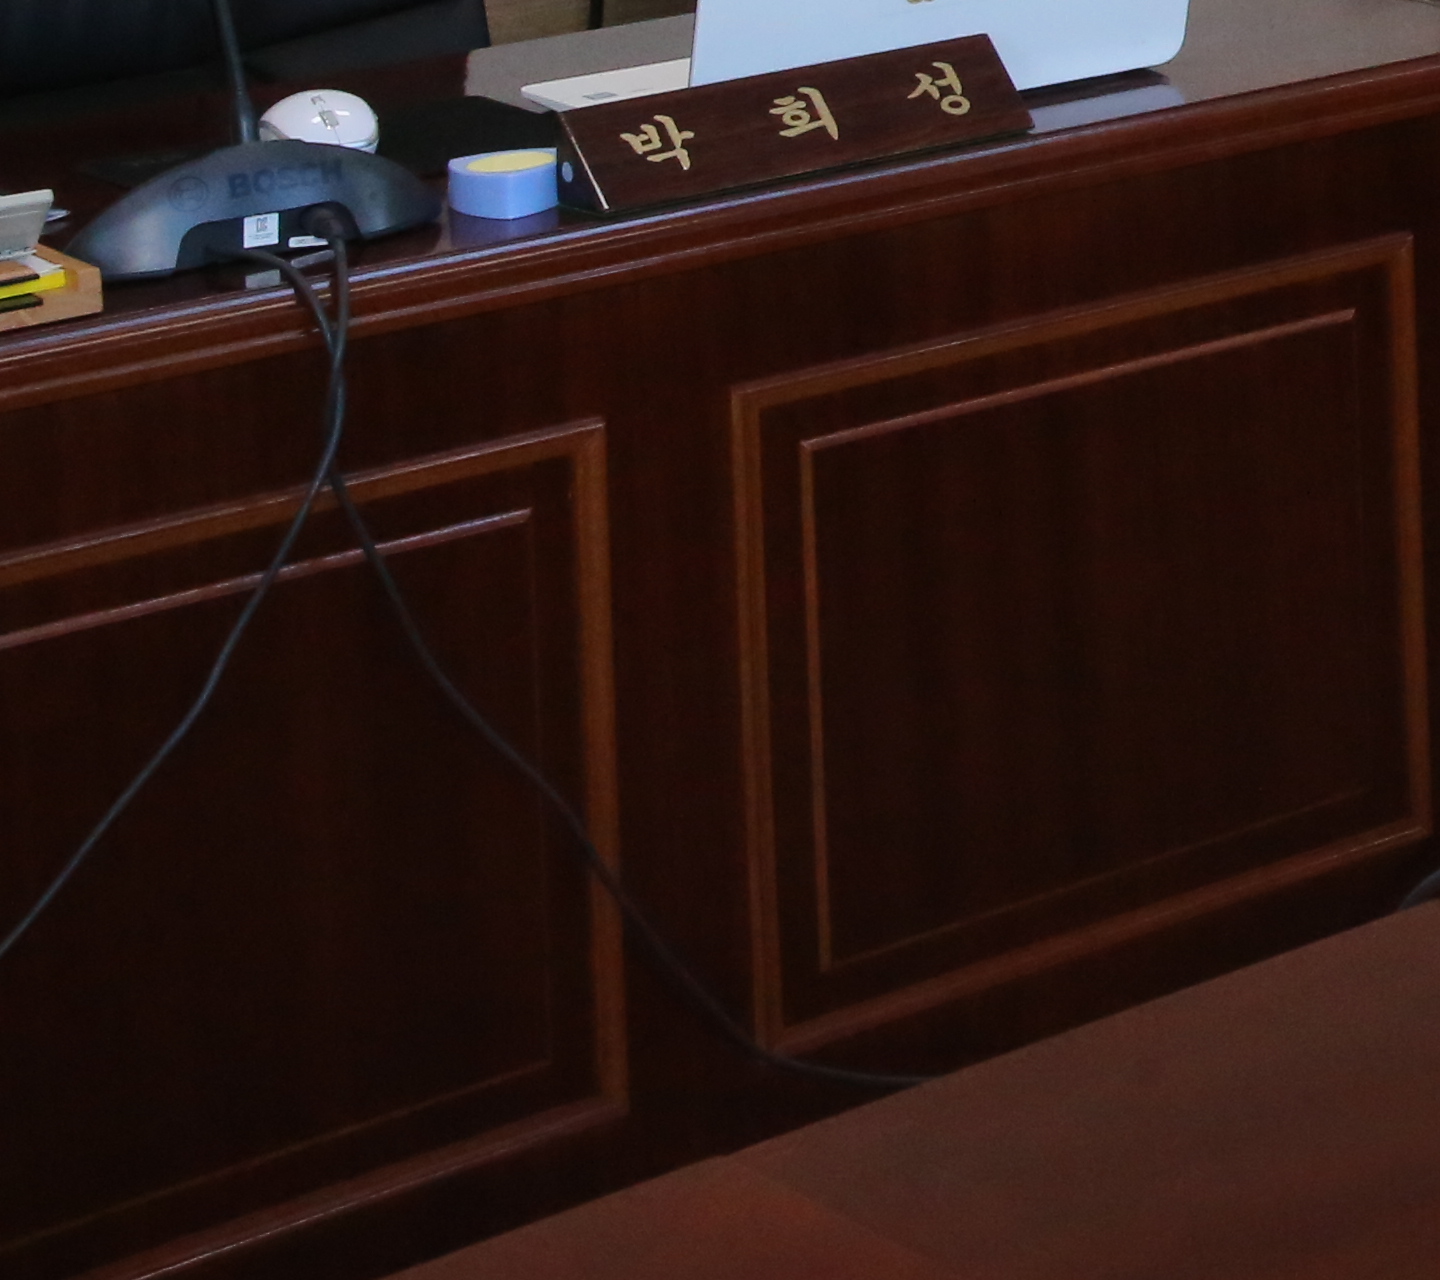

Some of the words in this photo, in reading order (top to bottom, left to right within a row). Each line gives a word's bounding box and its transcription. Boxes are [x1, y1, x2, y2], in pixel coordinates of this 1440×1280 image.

[620, 114, 696, 174] 박
[907, 61, 972, 117] 성
[227, 157, 346, 202] BOSCH
